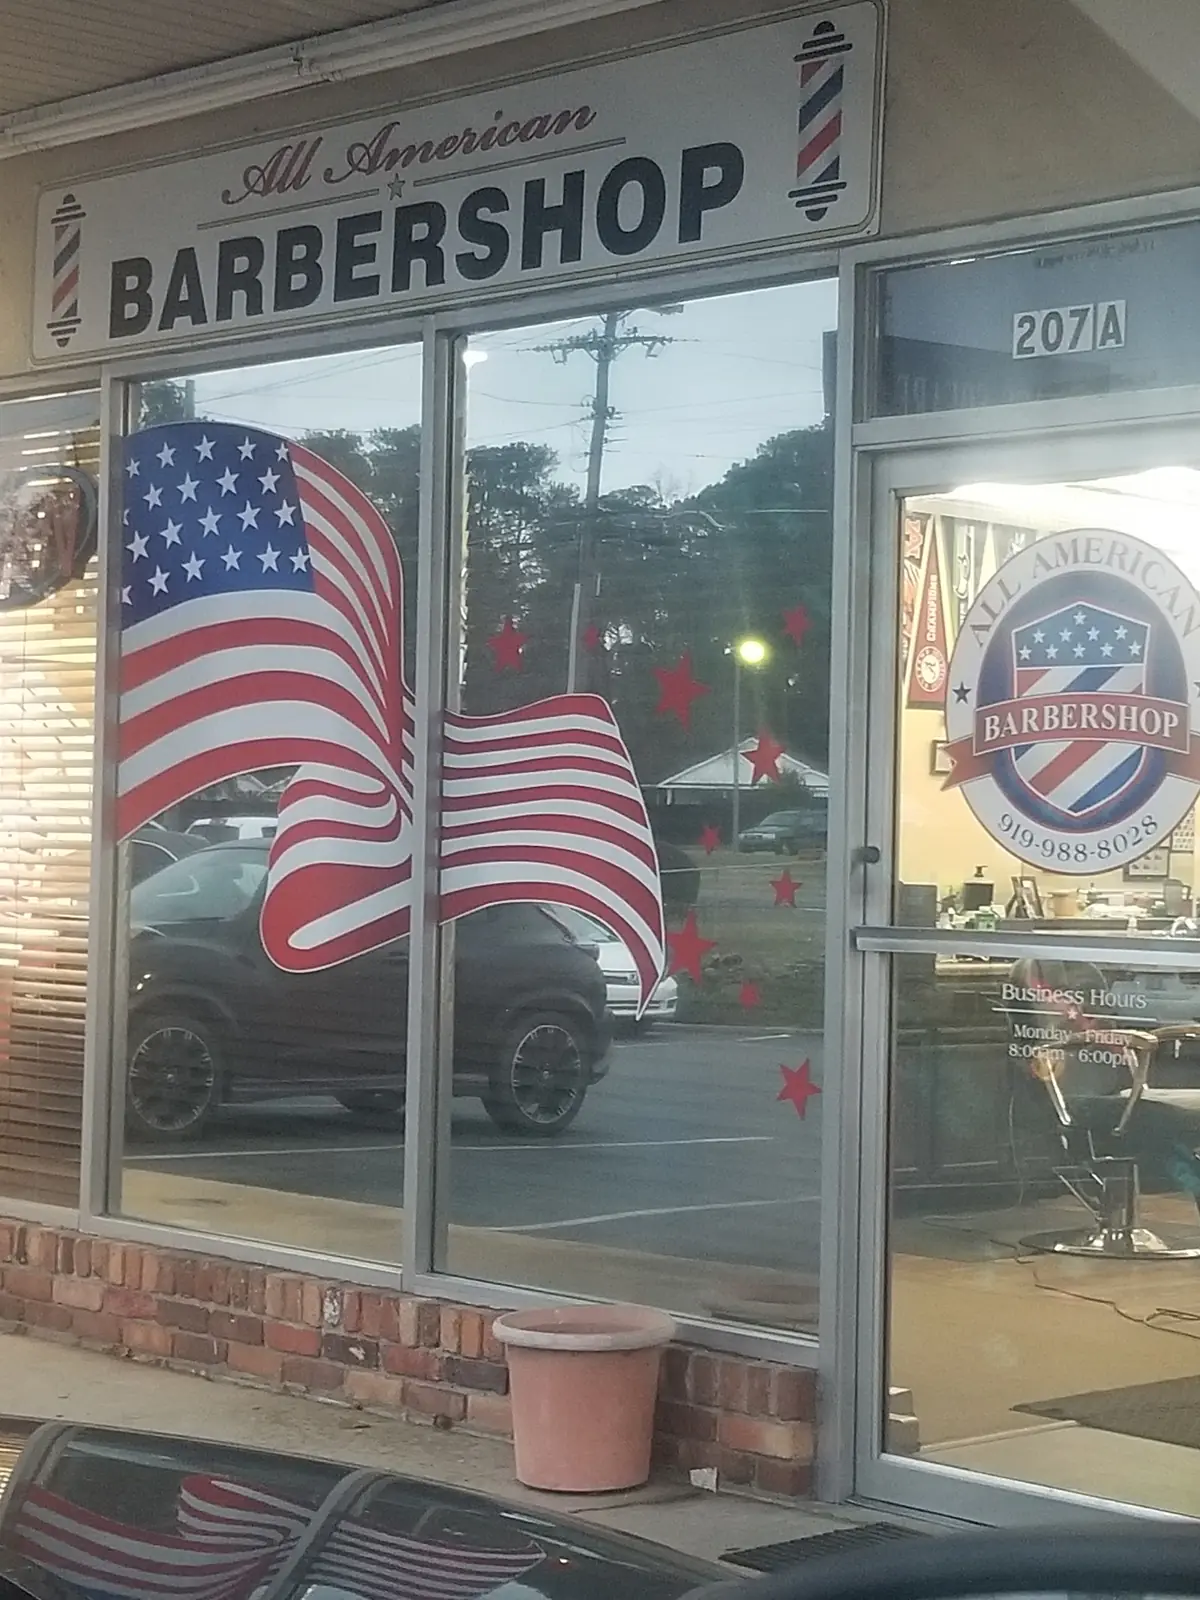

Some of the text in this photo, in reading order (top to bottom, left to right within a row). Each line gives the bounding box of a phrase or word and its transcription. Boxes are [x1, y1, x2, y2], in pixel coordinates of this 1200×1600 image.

[222, 104, 598, 206] All American
[109, 142, 745, 340] BARBERSHOP
[969, 578, 1022, 648] ALL
[1032, 536, 1200, 642] AMERICAN
[983, 703, 1179, 742] BARBERSHOP
[999, 814, 1158, 863] 919-988-8028
[1001, 983, 1147, 1009] Business Hours
[1013, 1023, 1073, 1044] Monday
[1085, 1030, 1133, 1049] Friday
